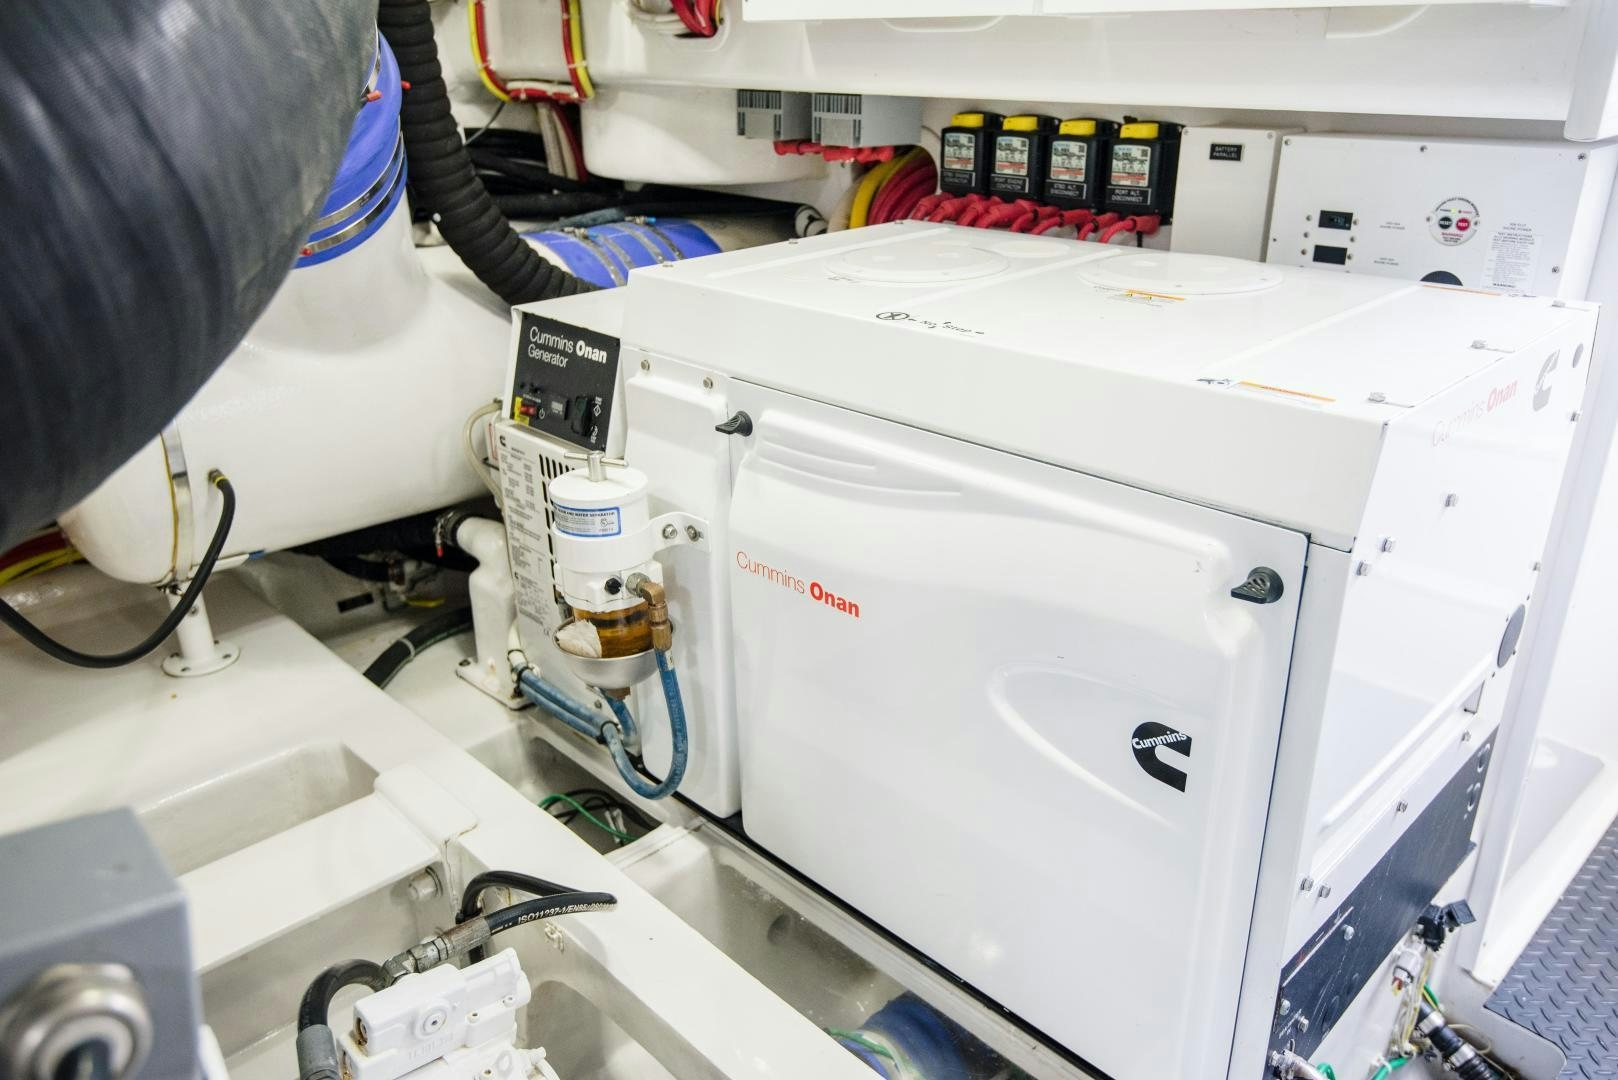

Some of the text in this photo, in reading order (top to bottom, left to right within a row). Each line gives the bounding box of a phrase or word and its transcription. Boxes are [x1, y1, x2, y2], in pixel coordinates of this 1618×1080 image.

[528, 344, 568, 368] Generator
[530, 326, 608, 364] Cummins Onan
[1432, 380, 1518, 448] Cummins Onan
[736, 550, 860, 618] Cummins Onan
[1132, 730, 1187, 750] Cummins
